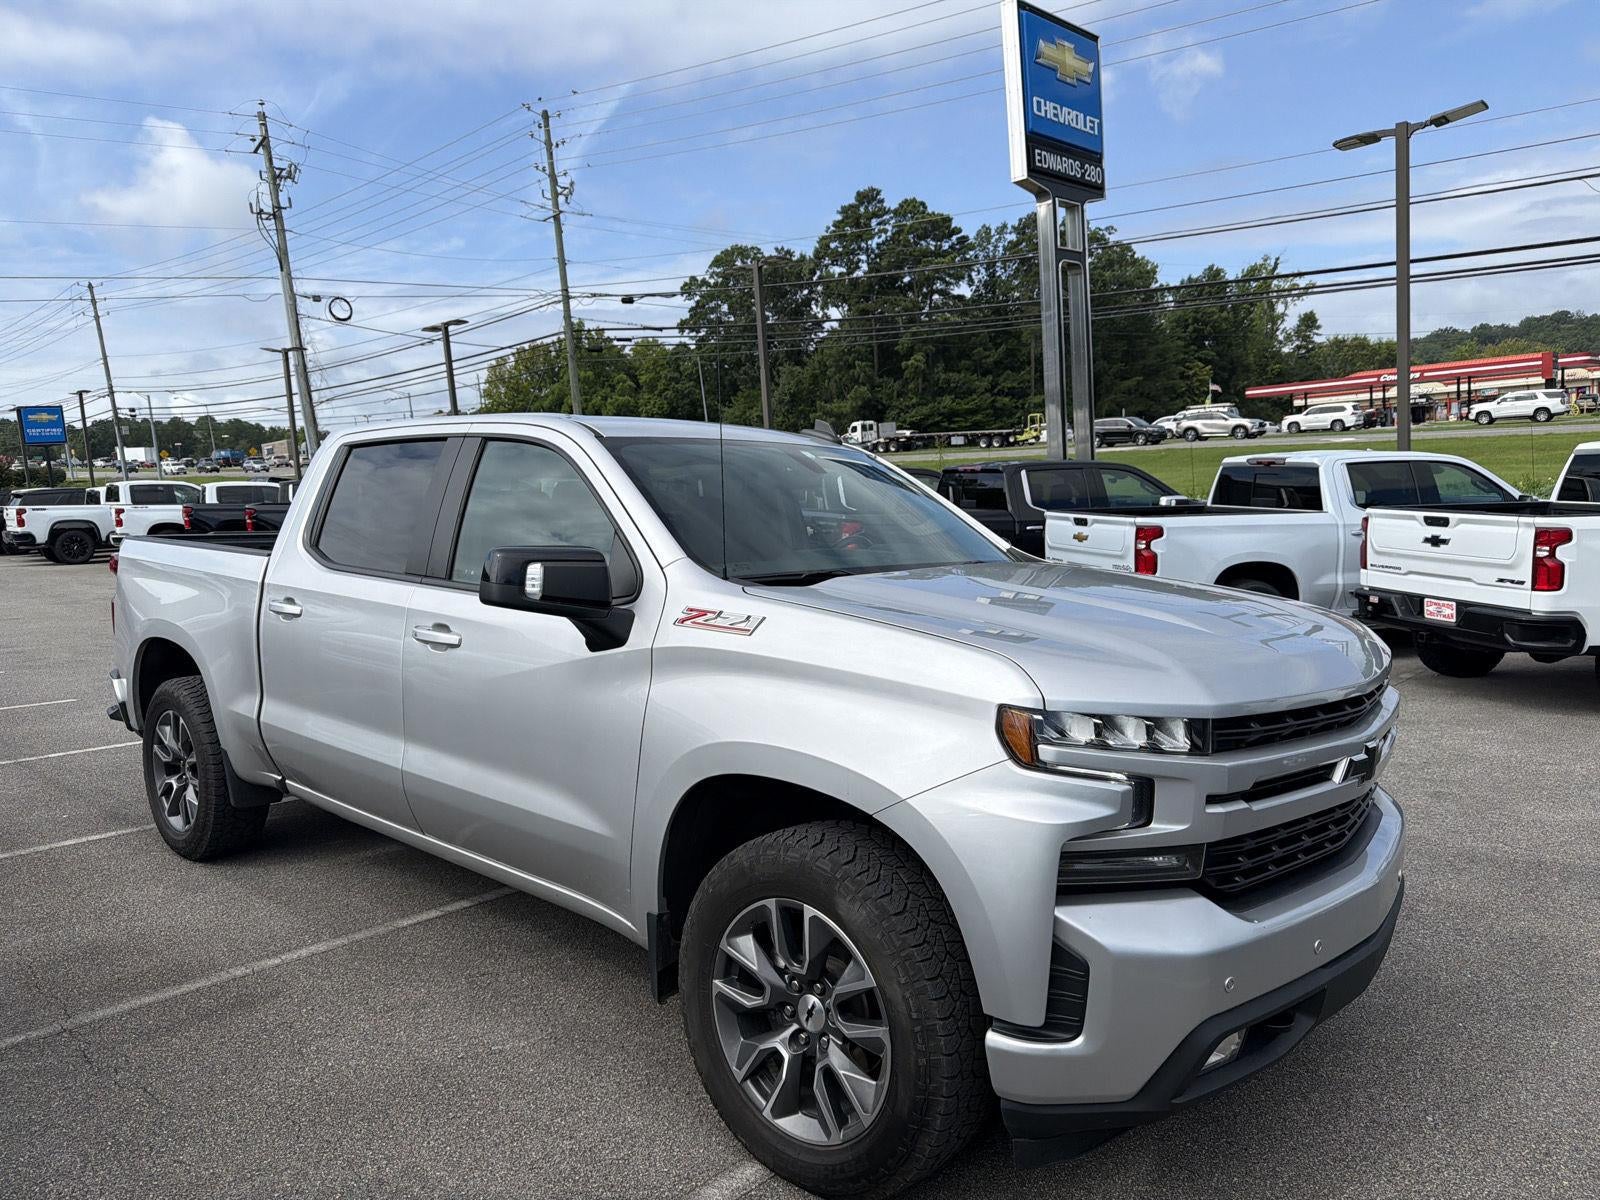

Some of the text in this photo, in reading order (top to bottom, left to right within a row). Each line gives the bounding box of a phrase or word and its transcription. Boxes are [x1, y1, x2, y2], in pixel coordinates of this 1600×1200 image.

[1033, 96, 1099, 135] CHEVROLET
[1035, 149, 1102, 184] EDWARDS-280
[673, 606, 767, 637] Z71
[1425, 600, 1455, 611] EDWARDS
